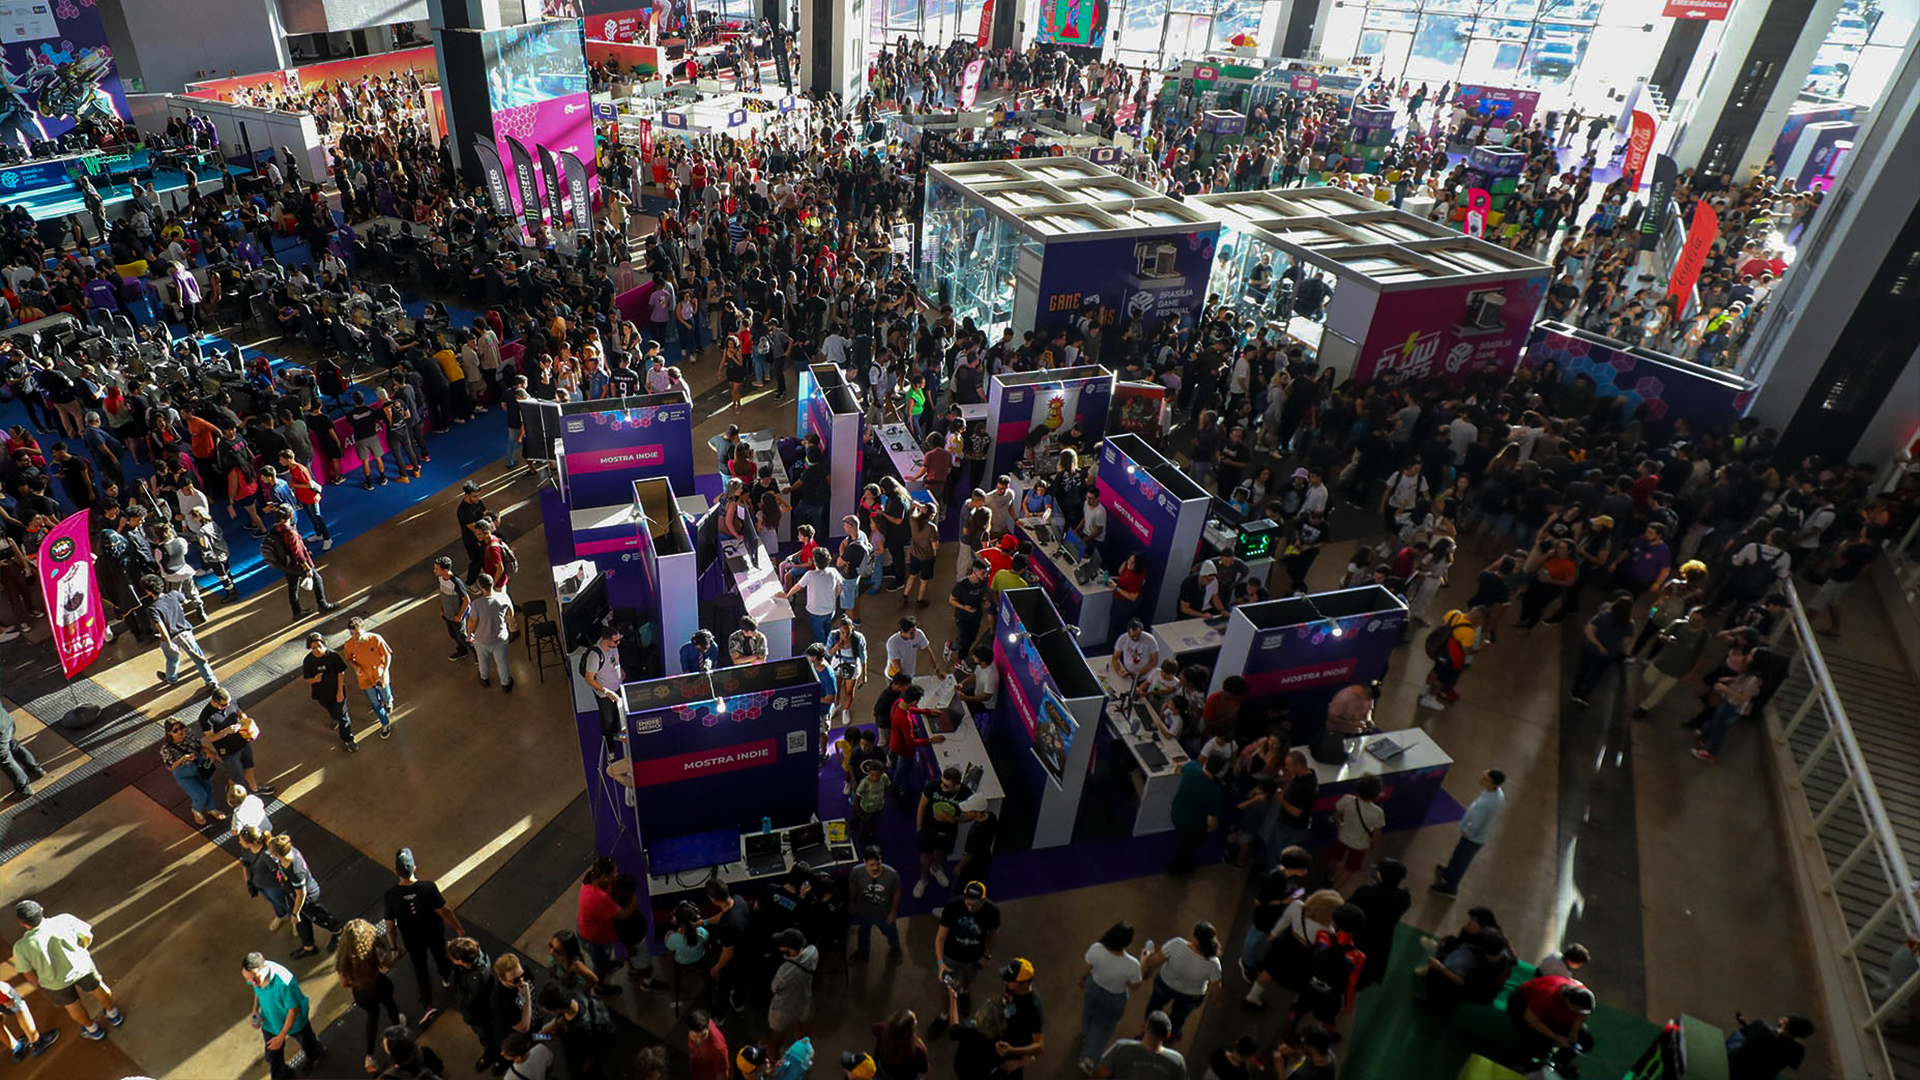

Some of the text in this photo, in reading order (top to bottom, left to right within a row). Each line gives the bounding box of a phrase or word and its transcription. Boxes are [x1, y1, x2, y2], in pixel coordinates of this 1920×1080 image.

[1049, 292, 1081, 312] GAME
[1160, 288, 1194, 299] BRASÍLIA
[1158, 299, 1179, 308] GAME
[600, 451, 658, 464] MOSTRA INDIE
[1113, 500, 1150, 537] MOSTRA INDIE
[1281, 667, 1349, 684] MOSTRA INDIE
[684, 748, 769, 770] MOSTRA INDIE
